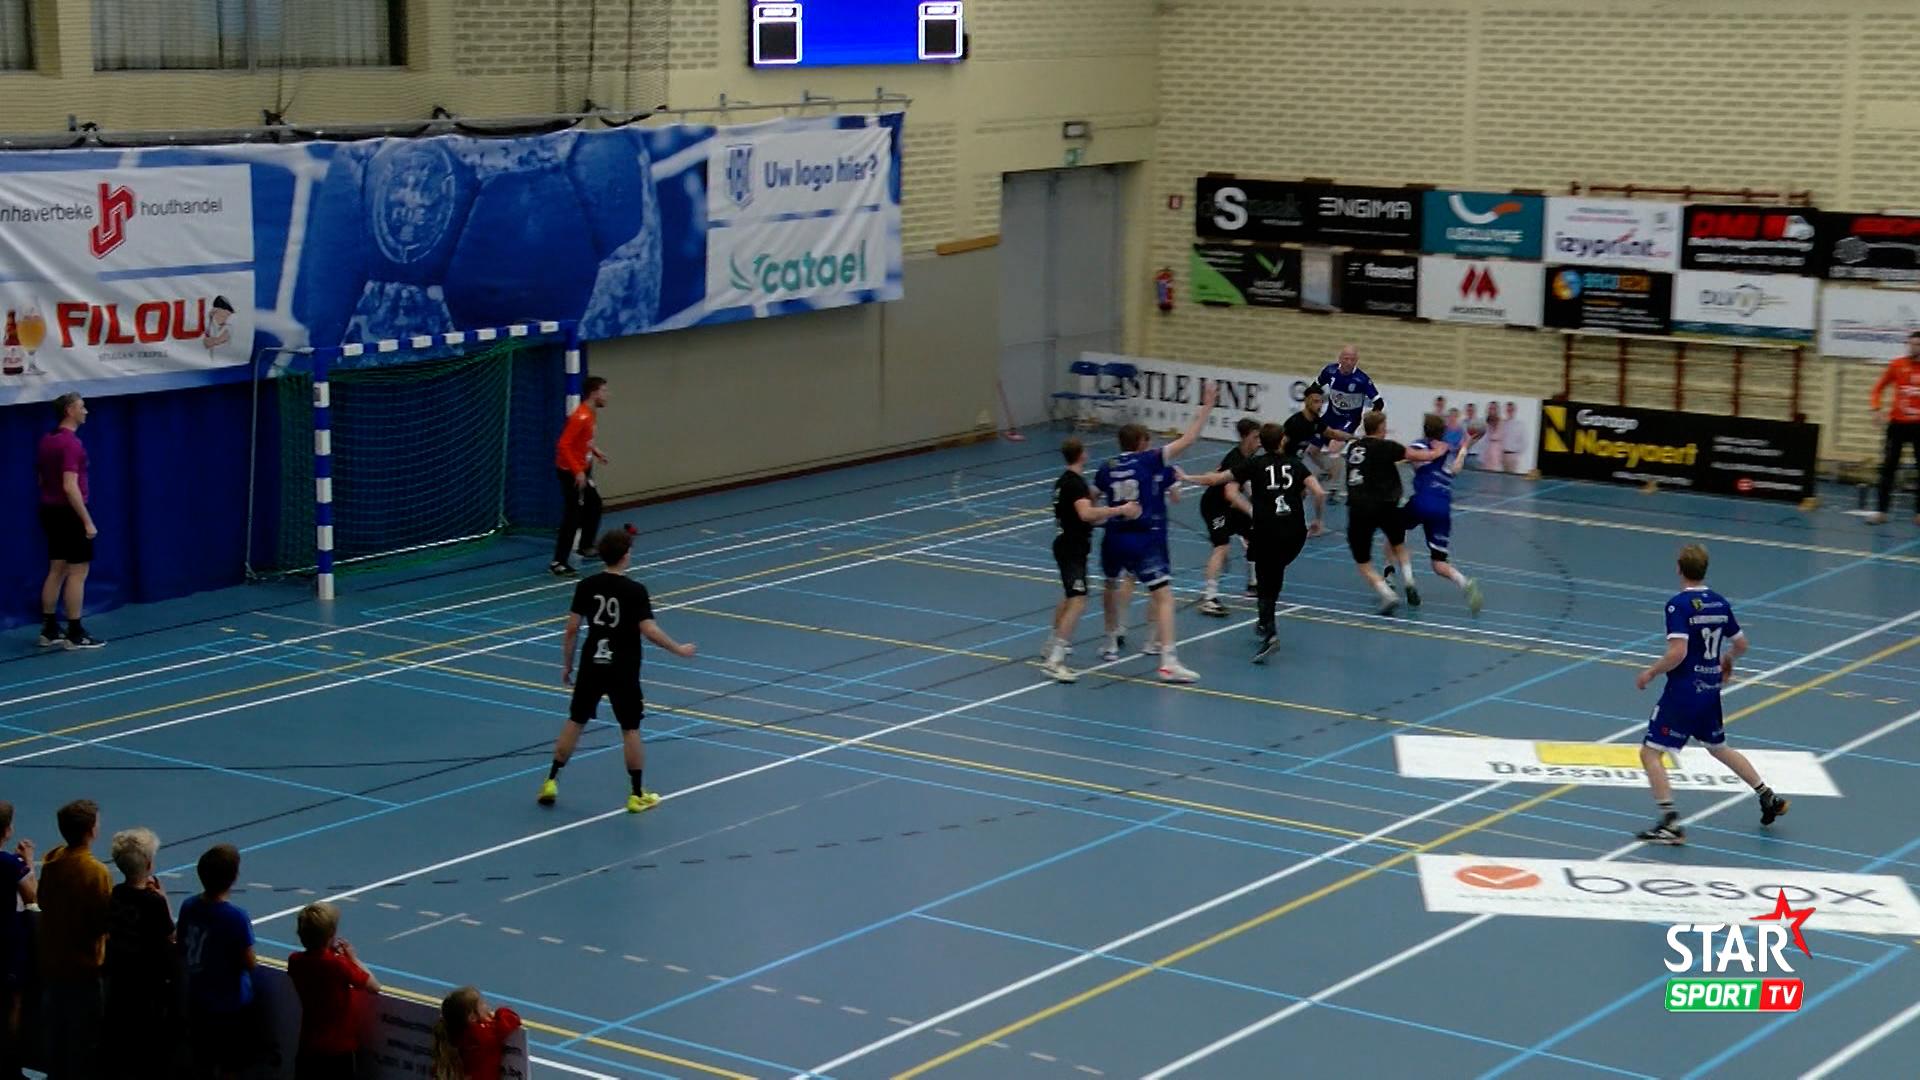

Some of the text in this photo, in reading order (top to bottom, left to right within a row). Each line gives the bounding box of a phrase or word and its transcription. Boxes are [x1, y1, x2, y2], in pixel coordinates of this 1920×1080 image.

[764, 153, 879, 192] Uw logo hier?
[140, 197, 223, 217] houthandel
[758, 239, 868, 295] catael
[56, 296, 207, 348] FILOU
[1264, 464, 1294, 490] 15
[592, 594, 621, 628] 29
[1562, 866, 1887, 907] besox
